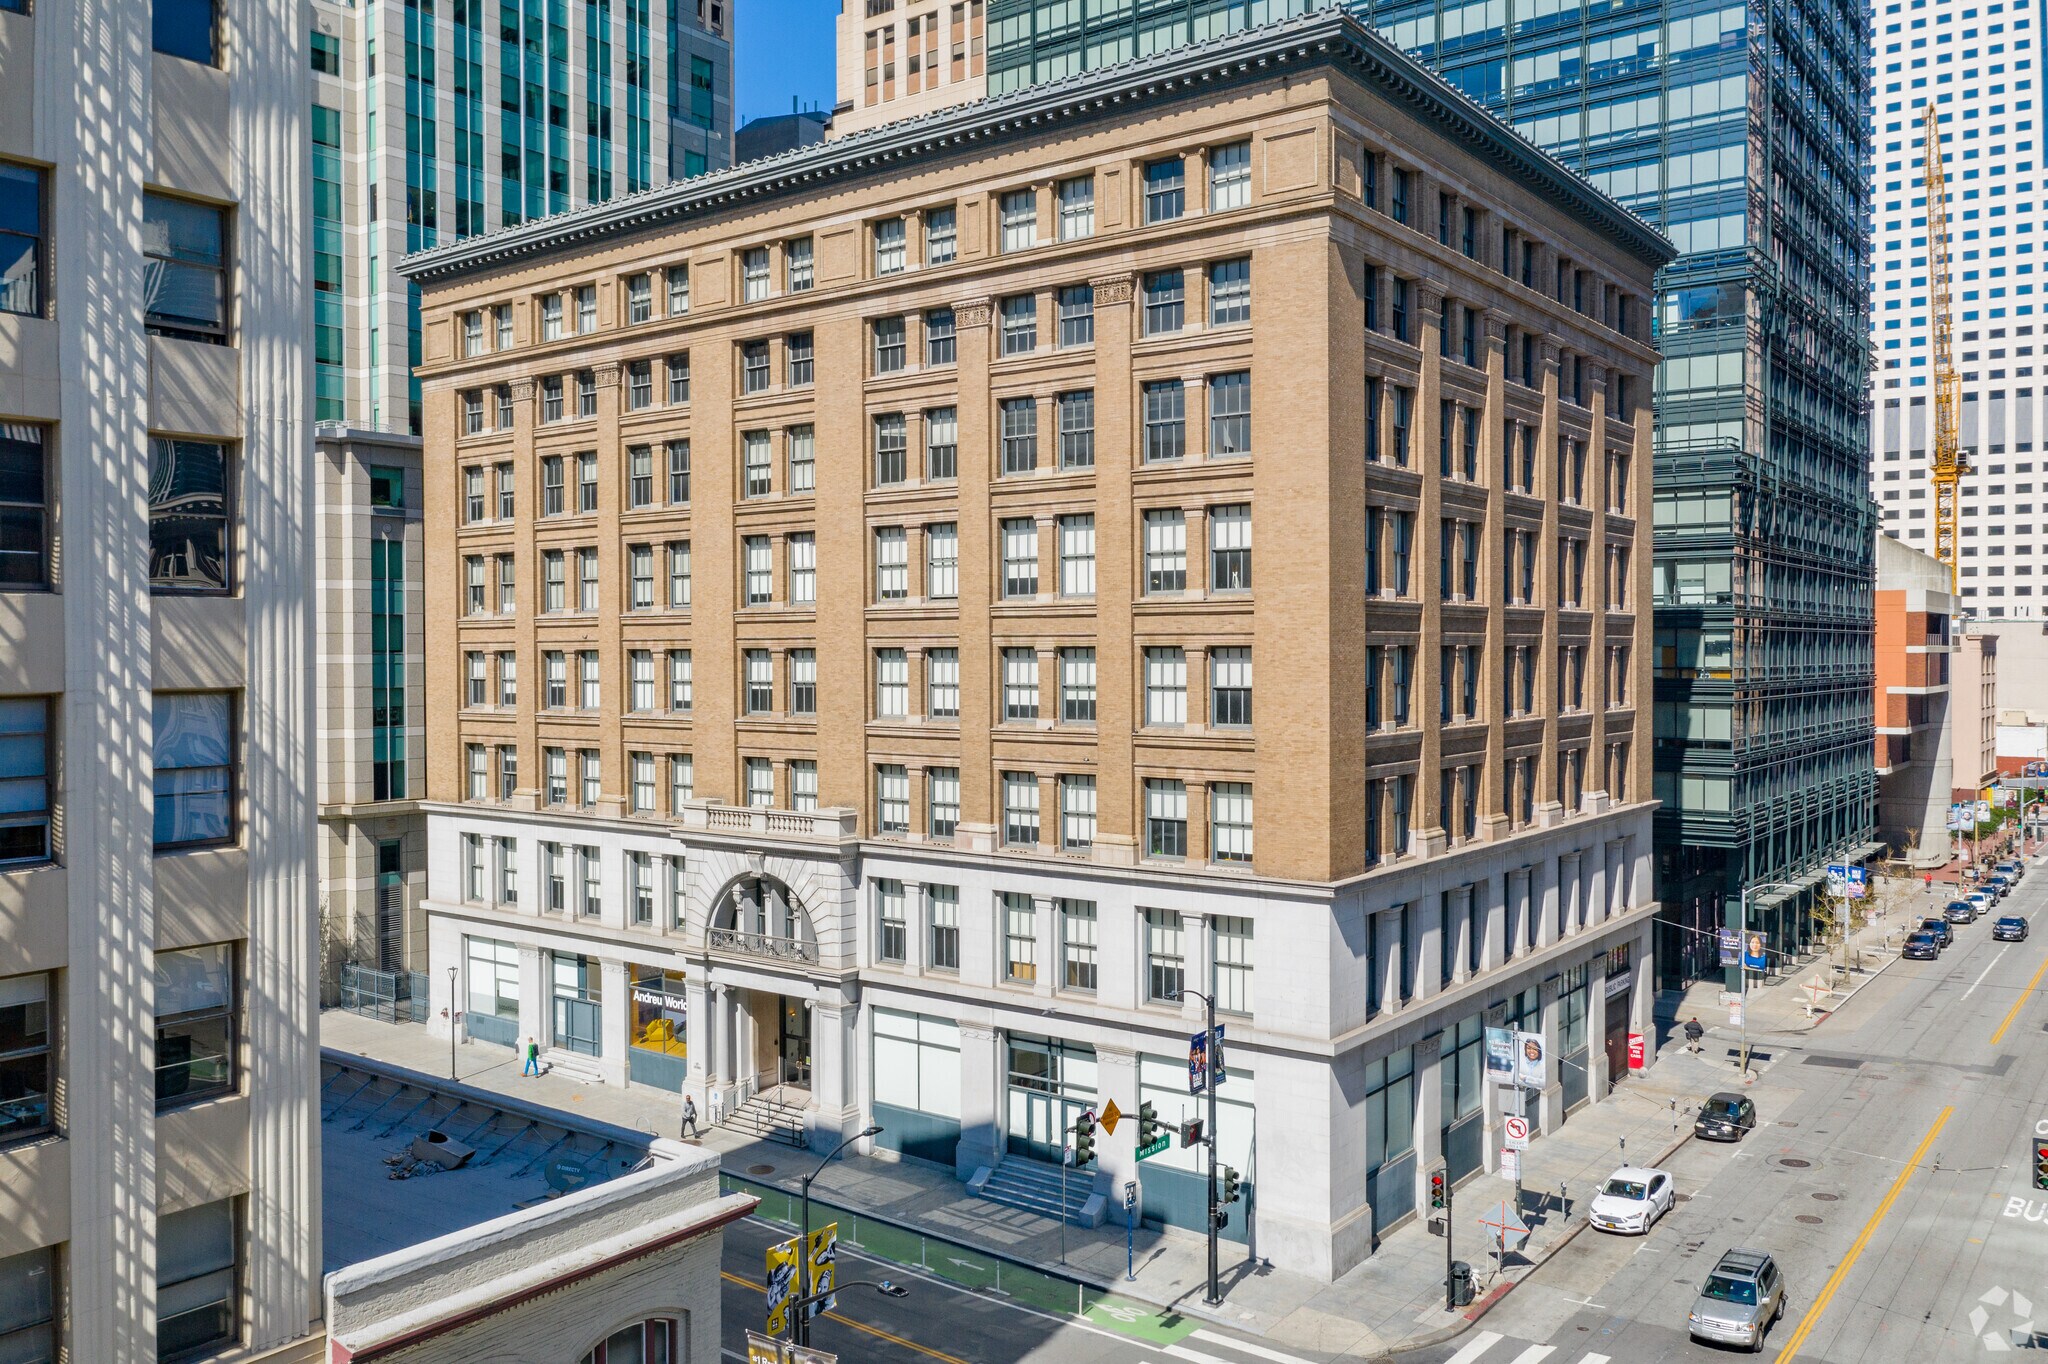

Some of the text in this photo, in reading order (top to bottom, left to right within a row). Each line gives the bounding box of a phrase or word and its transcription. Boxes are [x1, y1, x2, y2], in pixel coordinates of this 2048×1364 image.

[1605, 976, 1631, 994] PUBLIC PARKING
[633, 990, 662, 1005] Andreu
[1140, 1141, 1166, 1157] Mission
[561, 1165, 581, 1173] DIRECTV
